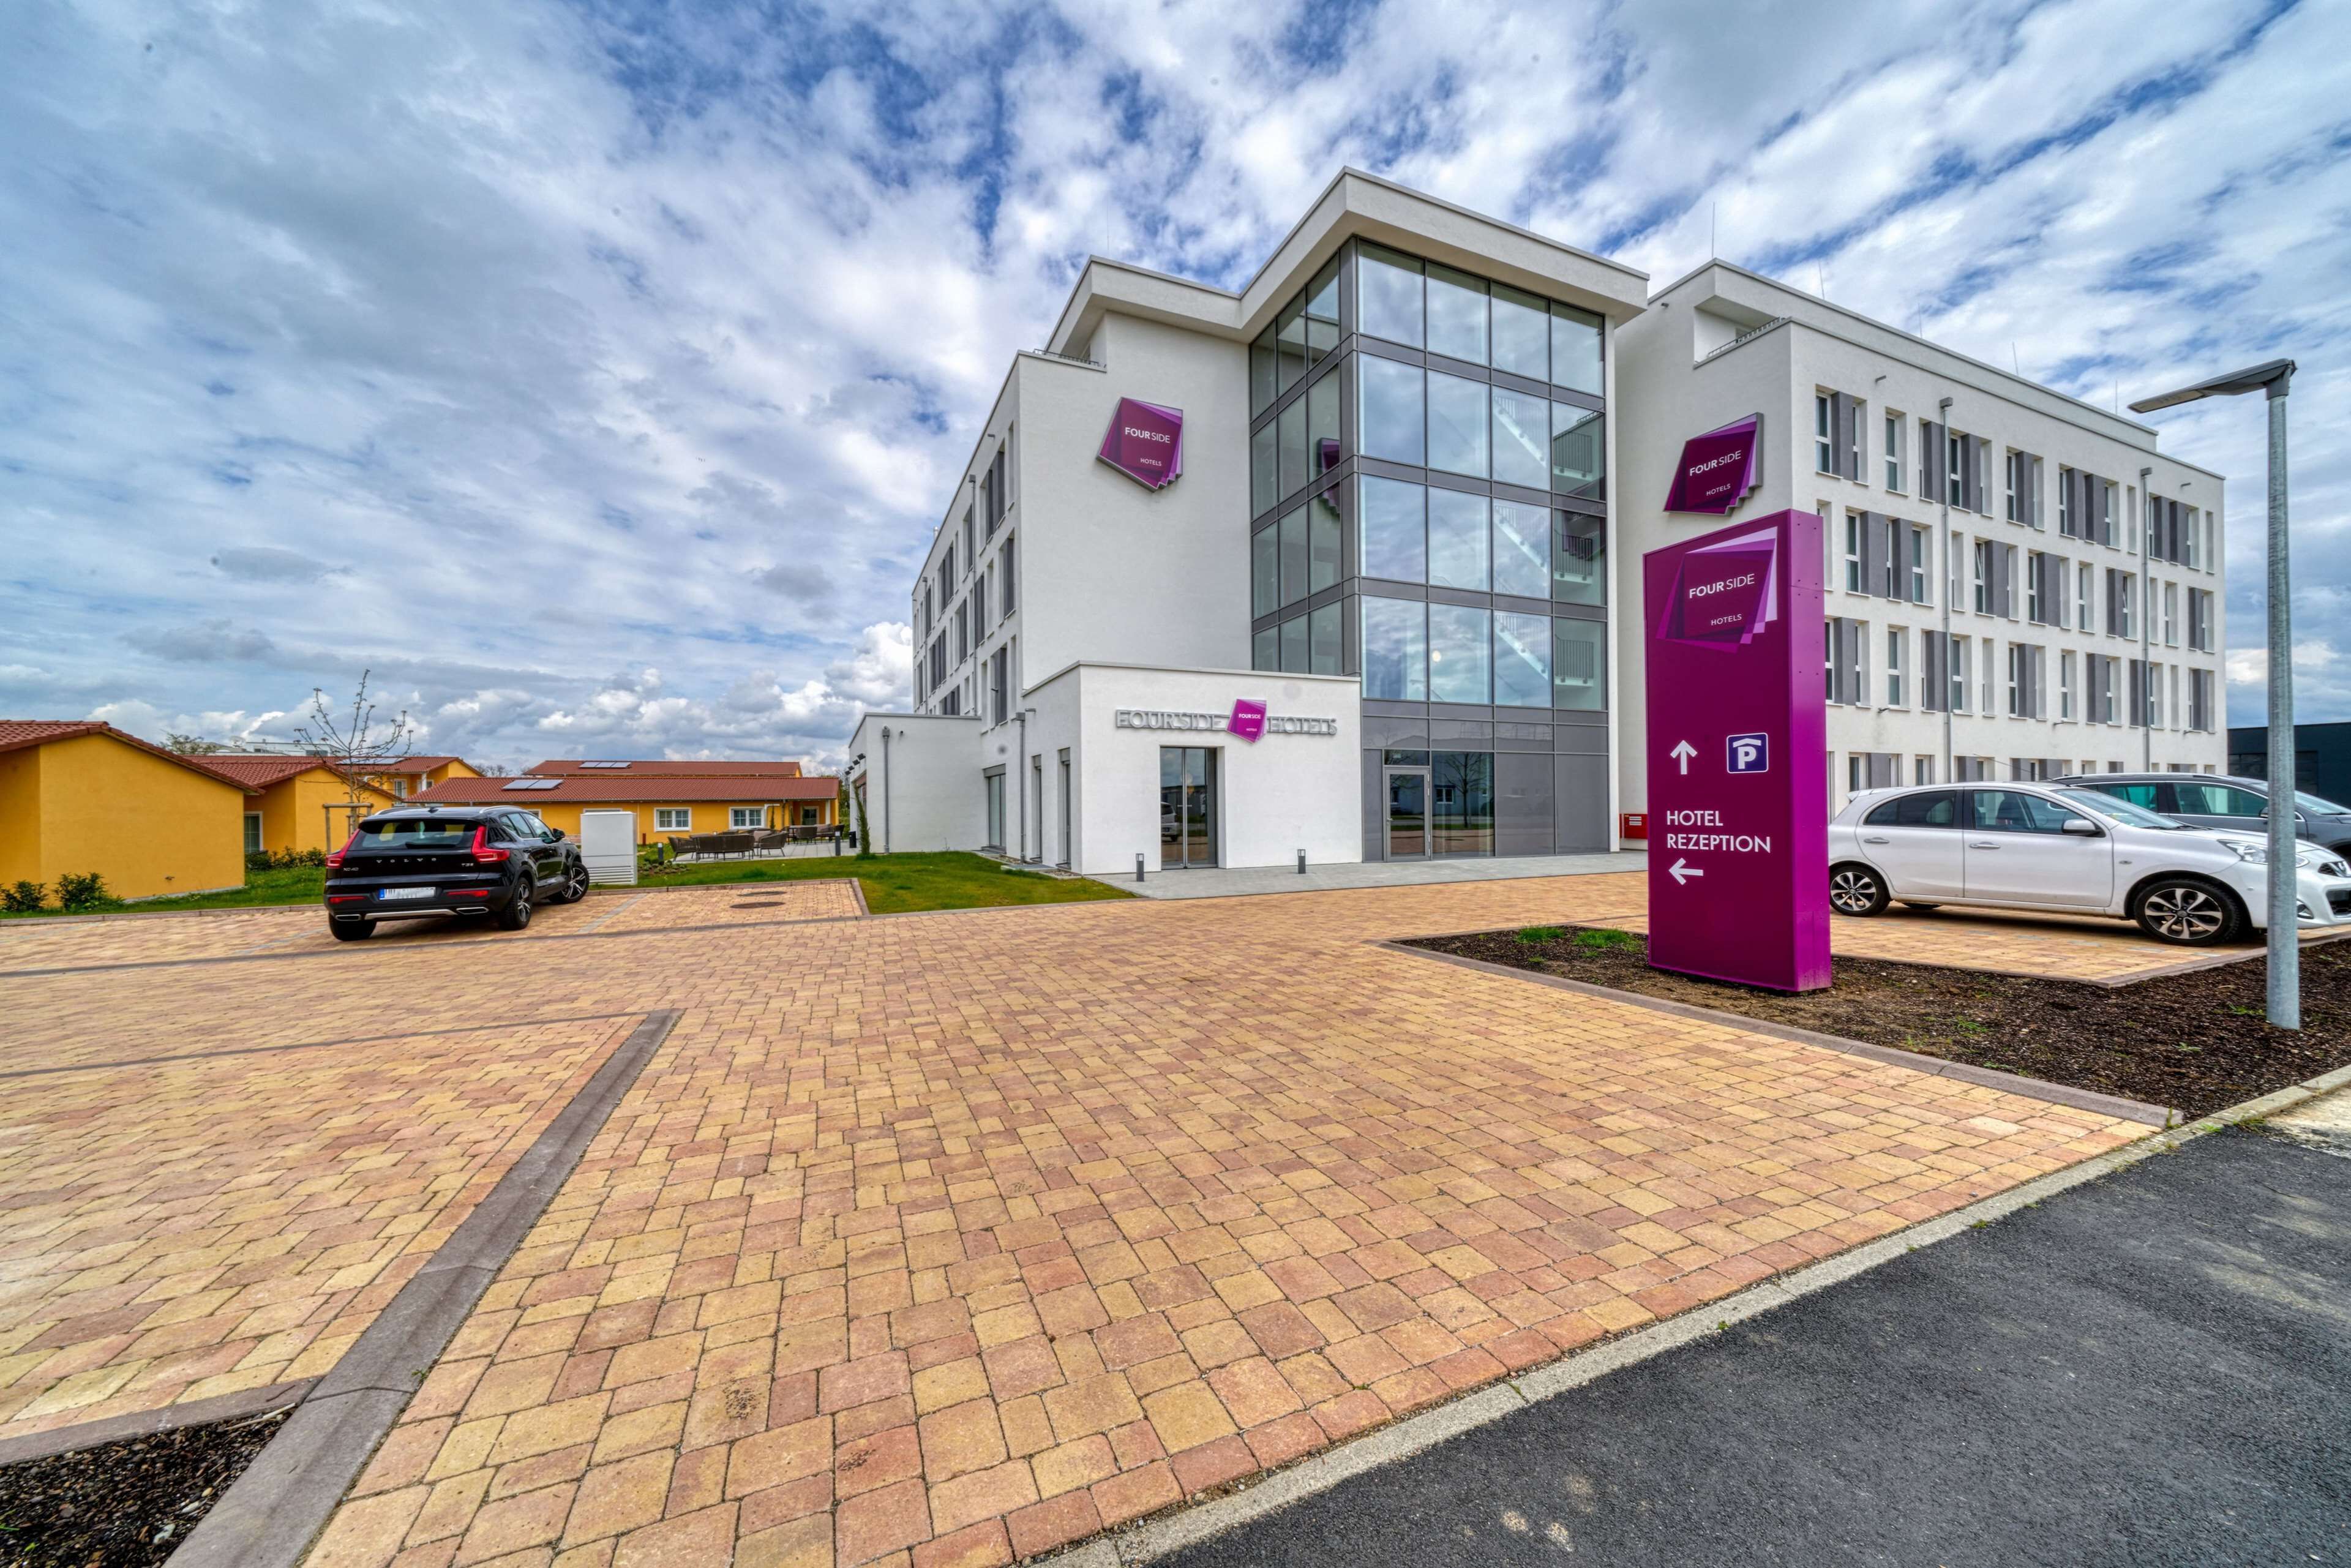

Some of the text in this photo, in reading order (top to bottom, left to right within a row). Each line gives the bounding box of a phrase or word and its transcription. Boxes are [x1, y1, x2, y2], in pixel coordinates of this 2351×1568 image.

[1140, 458, 1162, 467] HOTELS
[1706, 483, 1731, 496] HOTELS
[1711, 613, 1742, 626] HOTELS
[1738, 746, 1757, 770] P
[1667, 810, 1723, 827] HOTEL
[1667, 833, 1771, 853] REZEPTION
